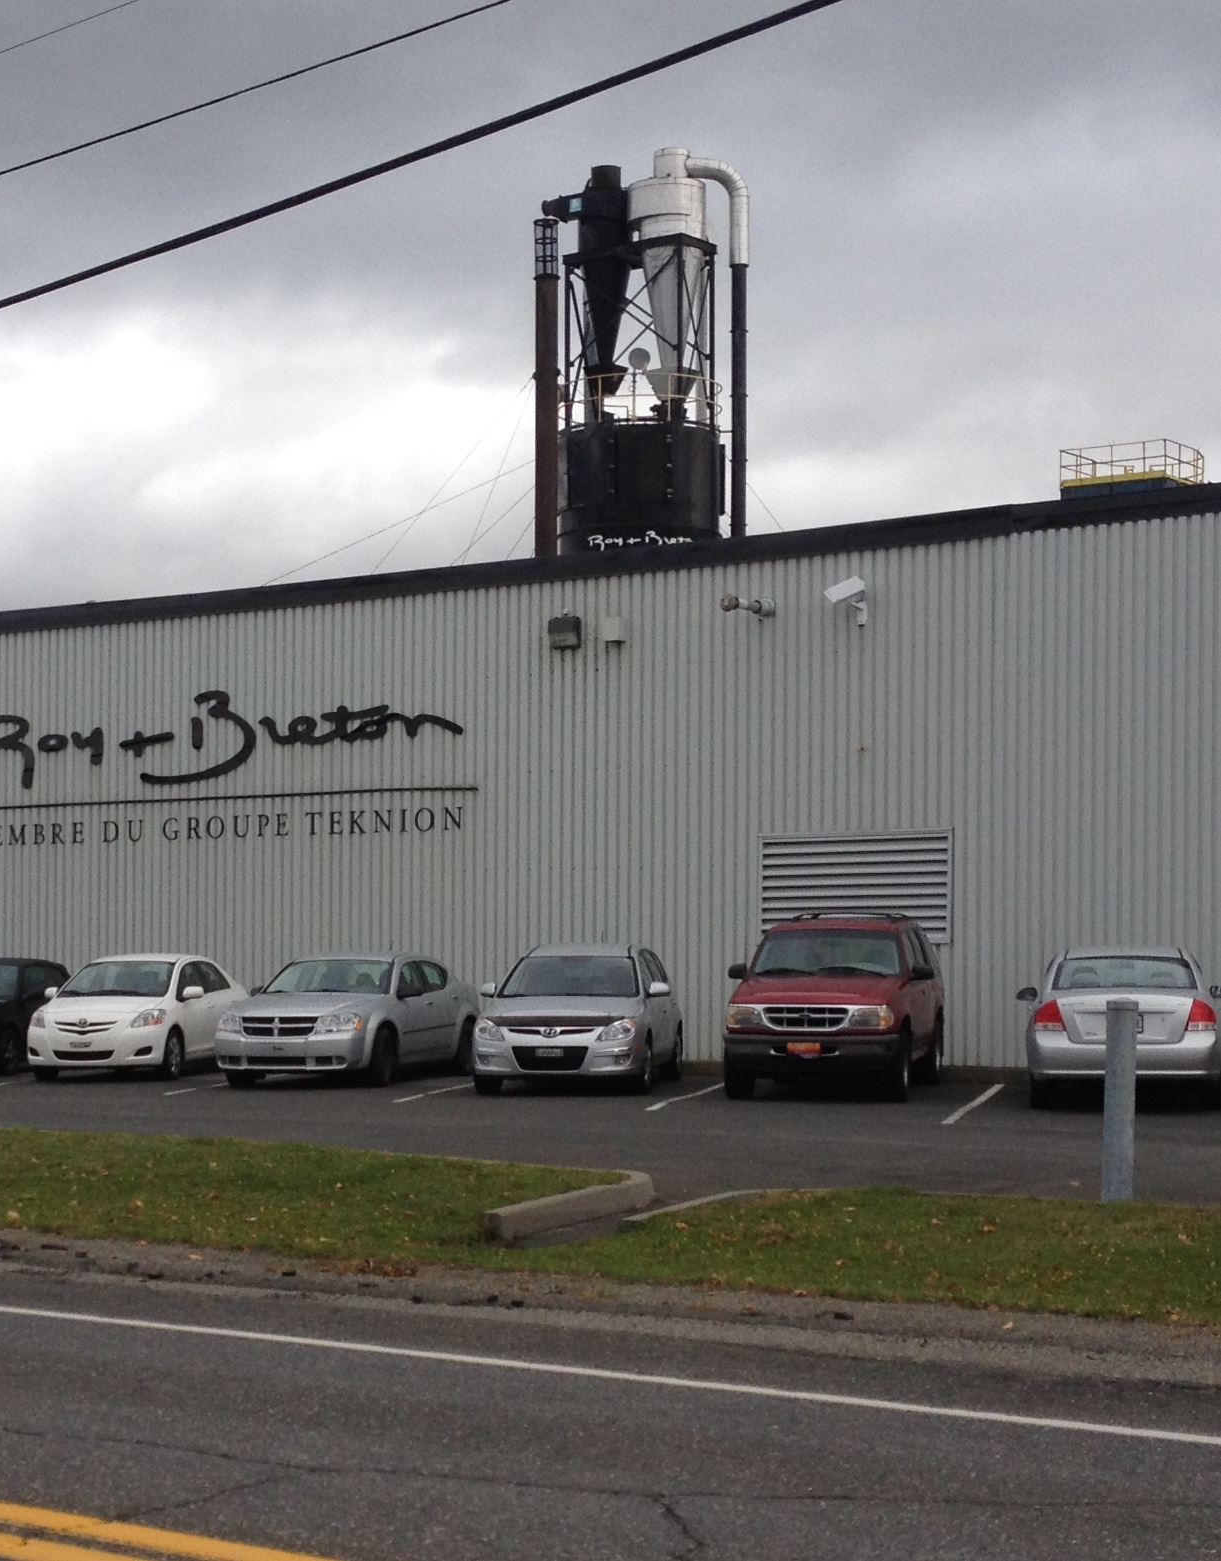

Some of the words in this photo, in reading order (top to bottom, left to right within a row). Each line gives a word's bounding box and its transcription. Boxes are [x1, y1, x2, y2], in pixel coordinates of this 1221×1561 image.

[587, 535, 623, 551] Roy
[119, 731, 175, 756] +
[140, 690, 463, 784] Breton
[102, 818, 143, 843] DU
[163, 812, 289, 841] GROUPE
[305, 806, 463, 835] TEKNION
